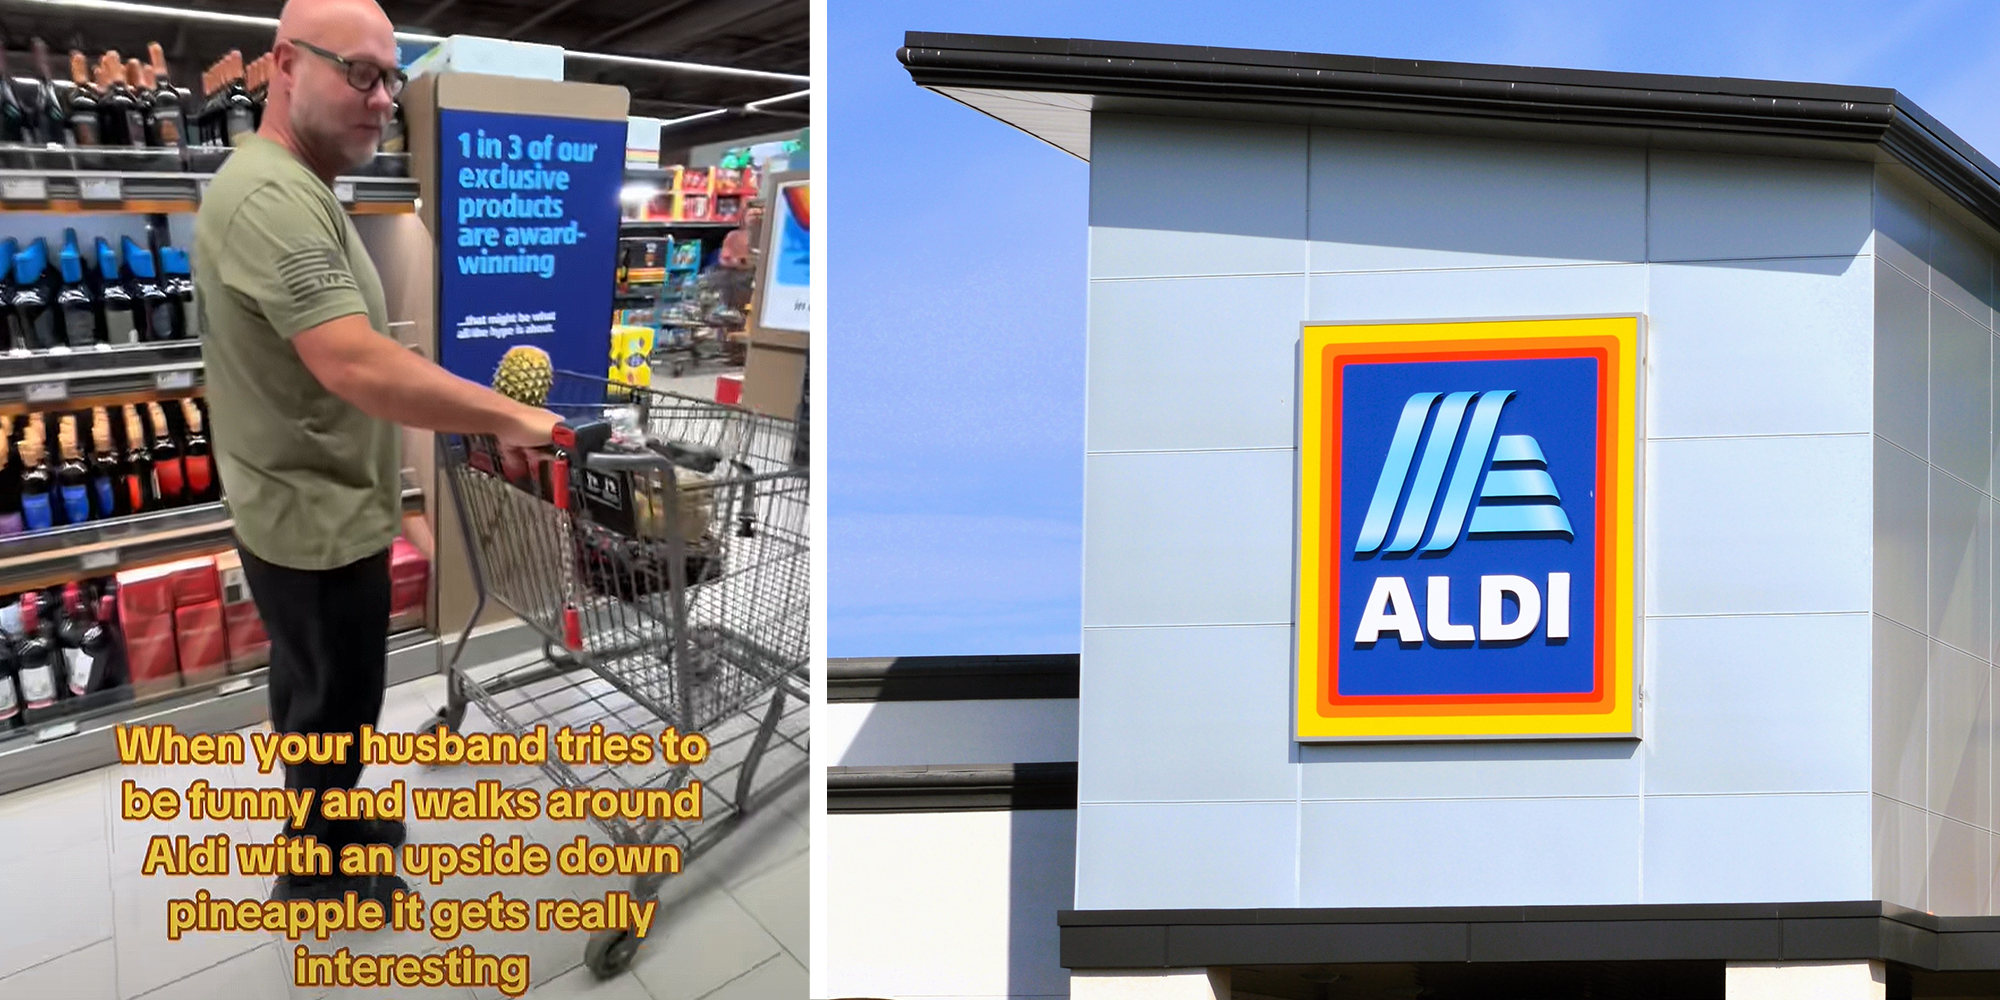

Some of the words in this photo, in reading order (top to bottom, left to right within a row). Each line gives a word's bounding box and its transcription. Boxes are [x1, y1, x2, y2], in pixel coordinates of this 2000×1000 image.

[458, 132, 471, 158] 1
[477, 129, 502, 159] in
[508, 134, 522, 160] 3
[528, 134, 554, 160] of
[557, 142, 598, 162] our
[458, 162, 570, 190] exclusive
[458, 192, 563, 224] products
[458, 227, 500, 247] are
[504, 220, 587, 246] award-
[457, 248, 555, 278] winning
[488, 313, 517, 326] might
[517, 312, 531, 323] be
[532, 311, 556, 321] what
[490, 326, 514, 339] hype
[515, 324, 524, 334] is
[1355, 572, 1570, 644] ALDI
